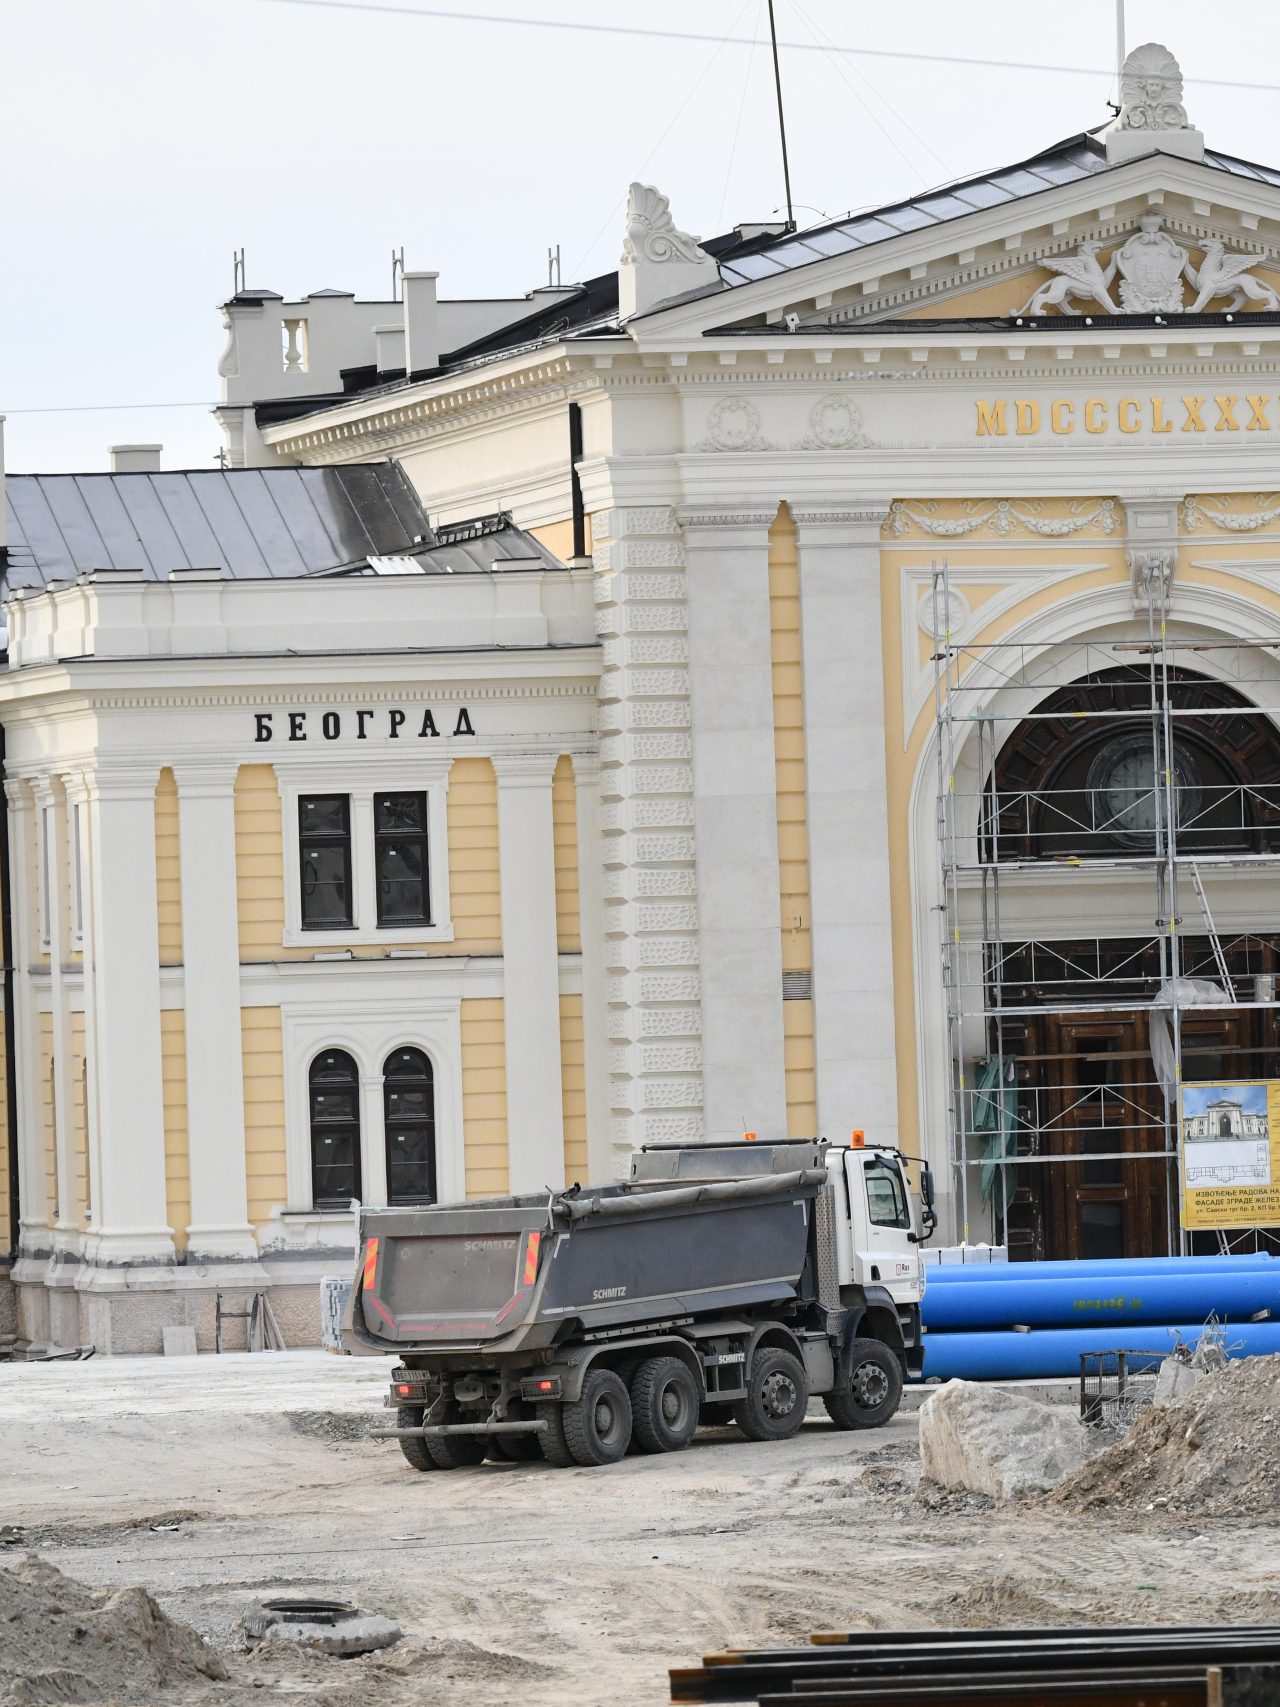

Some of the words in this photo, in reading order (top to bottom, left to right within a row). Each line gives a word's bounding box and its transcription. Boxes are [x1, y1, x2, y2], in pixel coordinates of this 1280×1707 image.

[254, 708, 475, 742] БЕОГРАД
[1239, 1188, 1268, 1196] РАДОВА
[1195, 1198, 1224, 1206] ФАСАДЕ
[1226, 1197, 1253, 1205] ЗГРАДЕ
[463, 1239, 516, 1251] SCHMITZ
[593, 1286, 627, 1300] SCHMITZ
[719, 1352, 745, 1364] SCHMITZ
